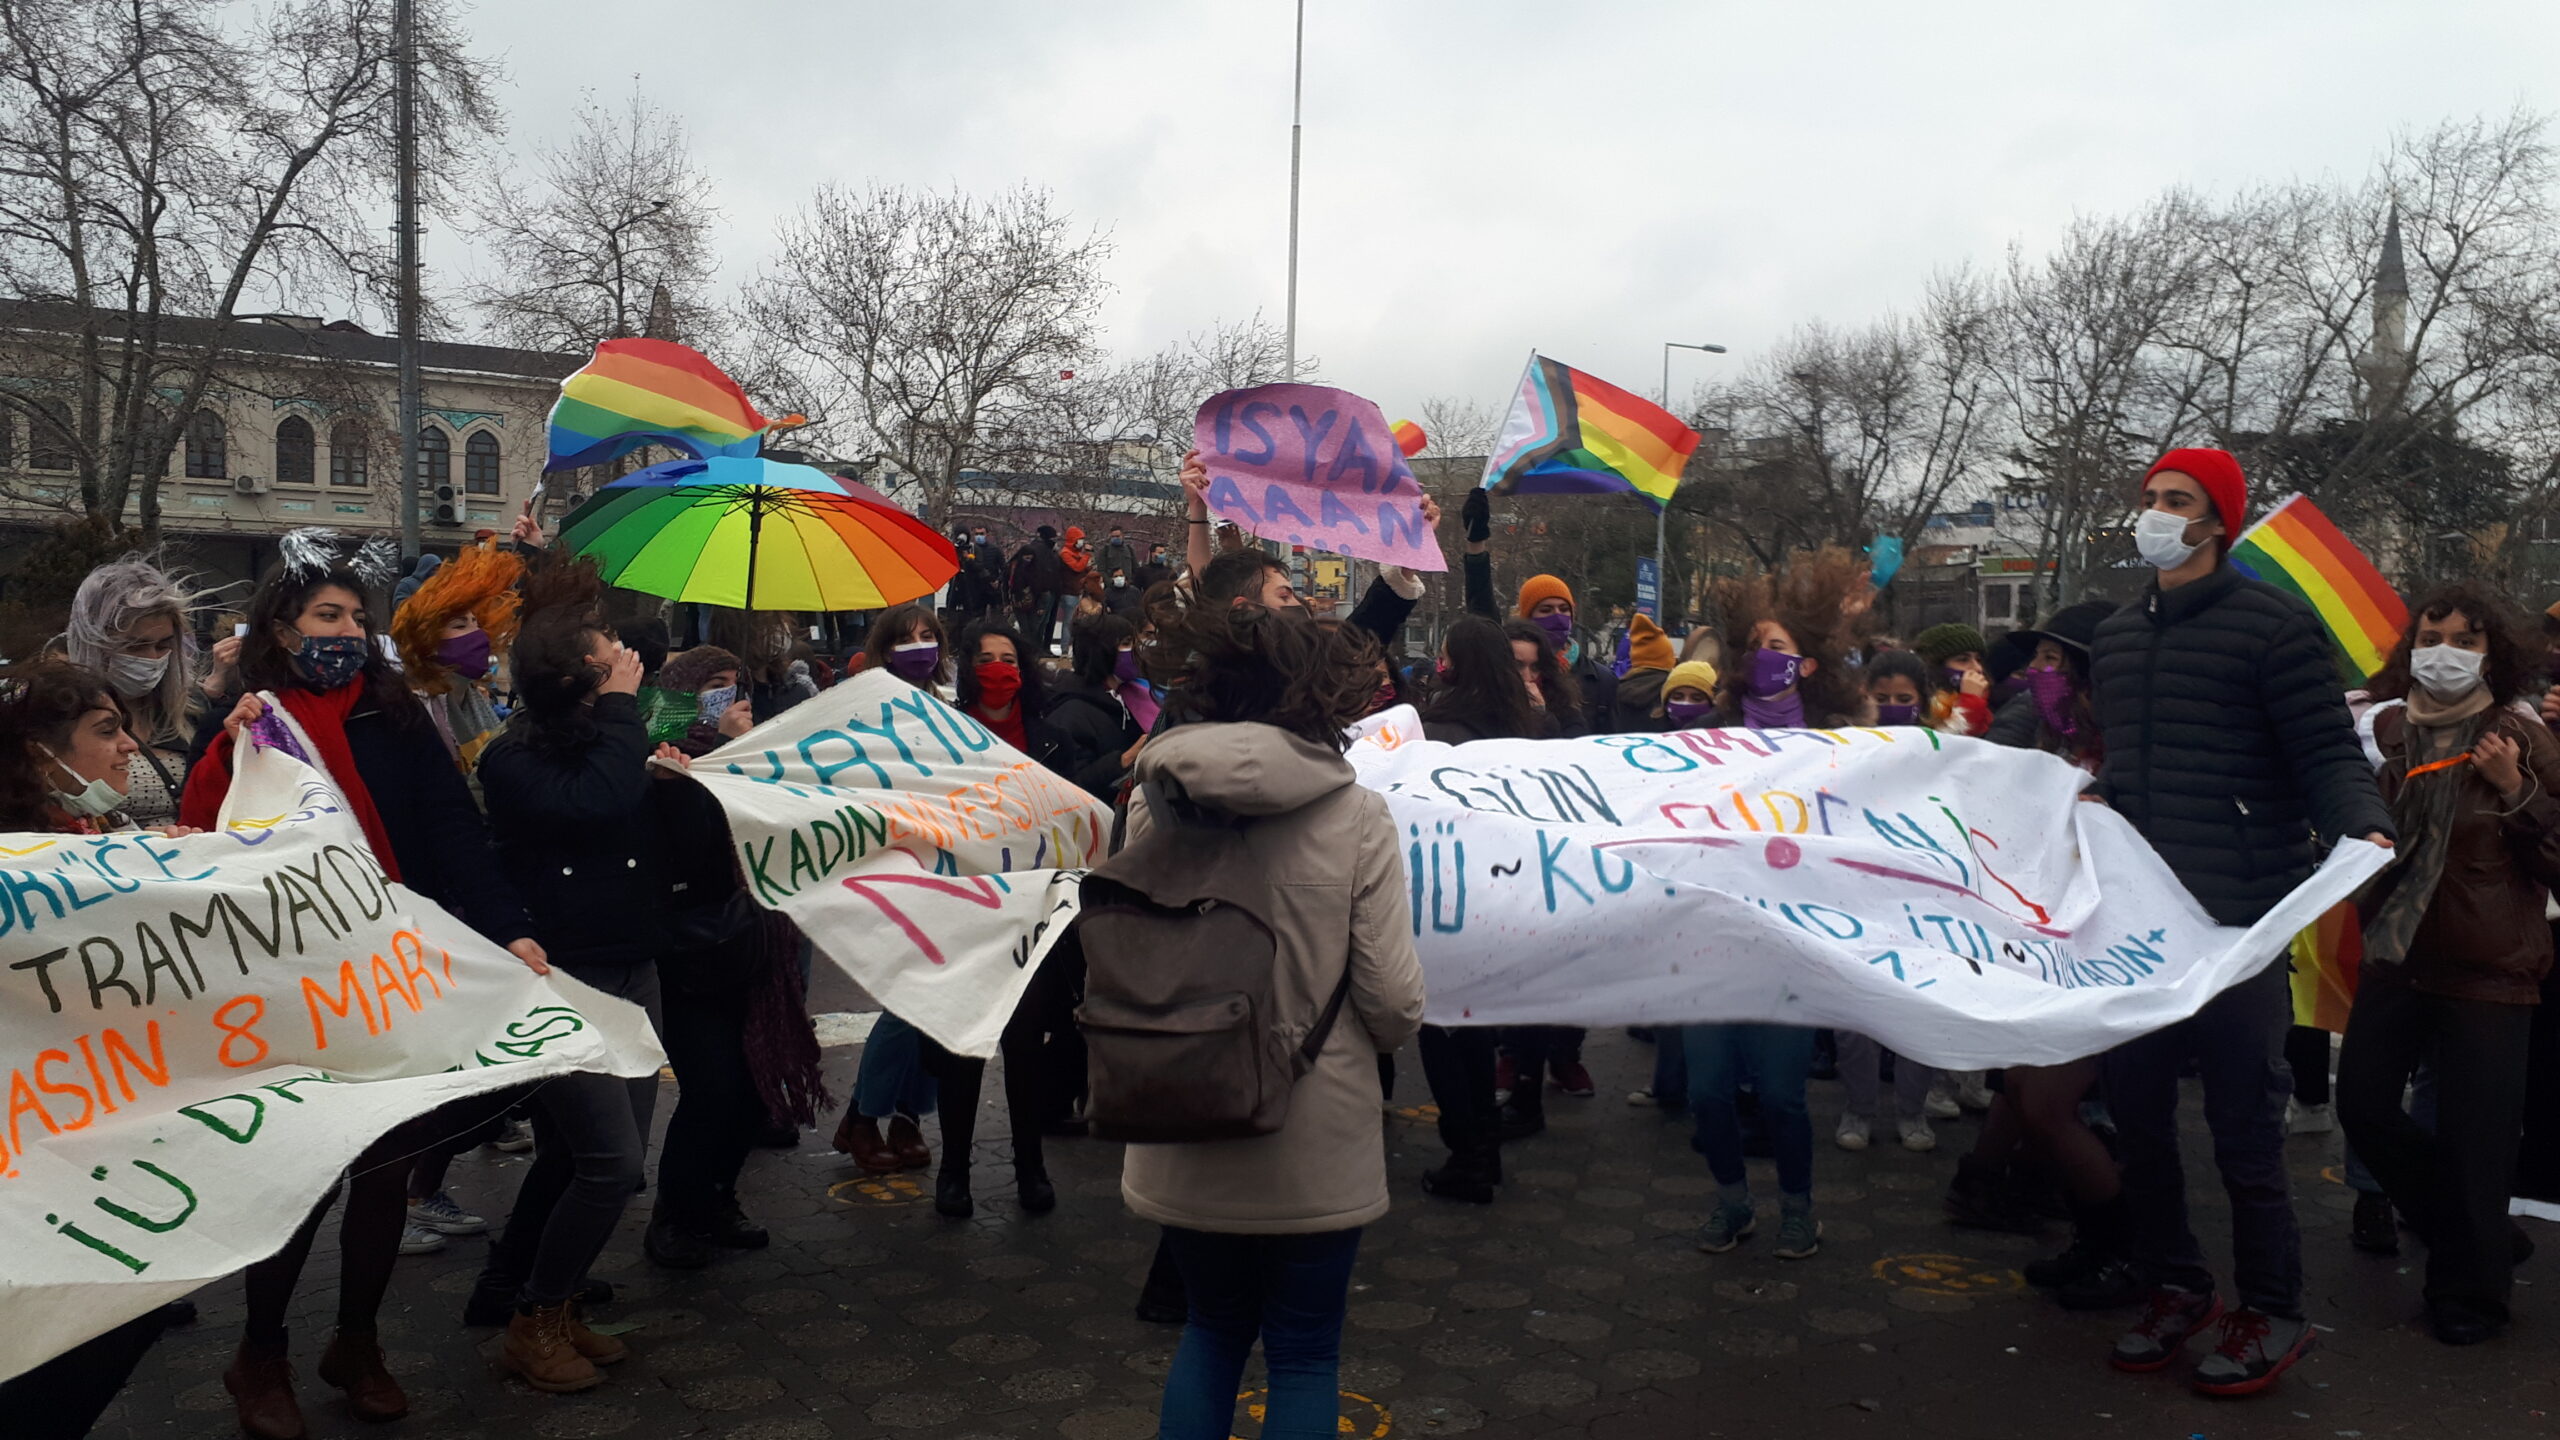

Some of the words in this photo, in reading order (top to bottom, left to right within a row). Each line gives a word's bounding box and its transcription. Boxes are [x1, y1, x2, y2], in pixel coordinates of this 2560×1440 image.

[726, 690, 997, 798] KAYYU
[745, 805, 887, 905] KADIN
[1409, 820, 1466, 937] İÜ
[213, 994, 269, 1068] 8
[45, 1138, 198, 1274] İÜ
